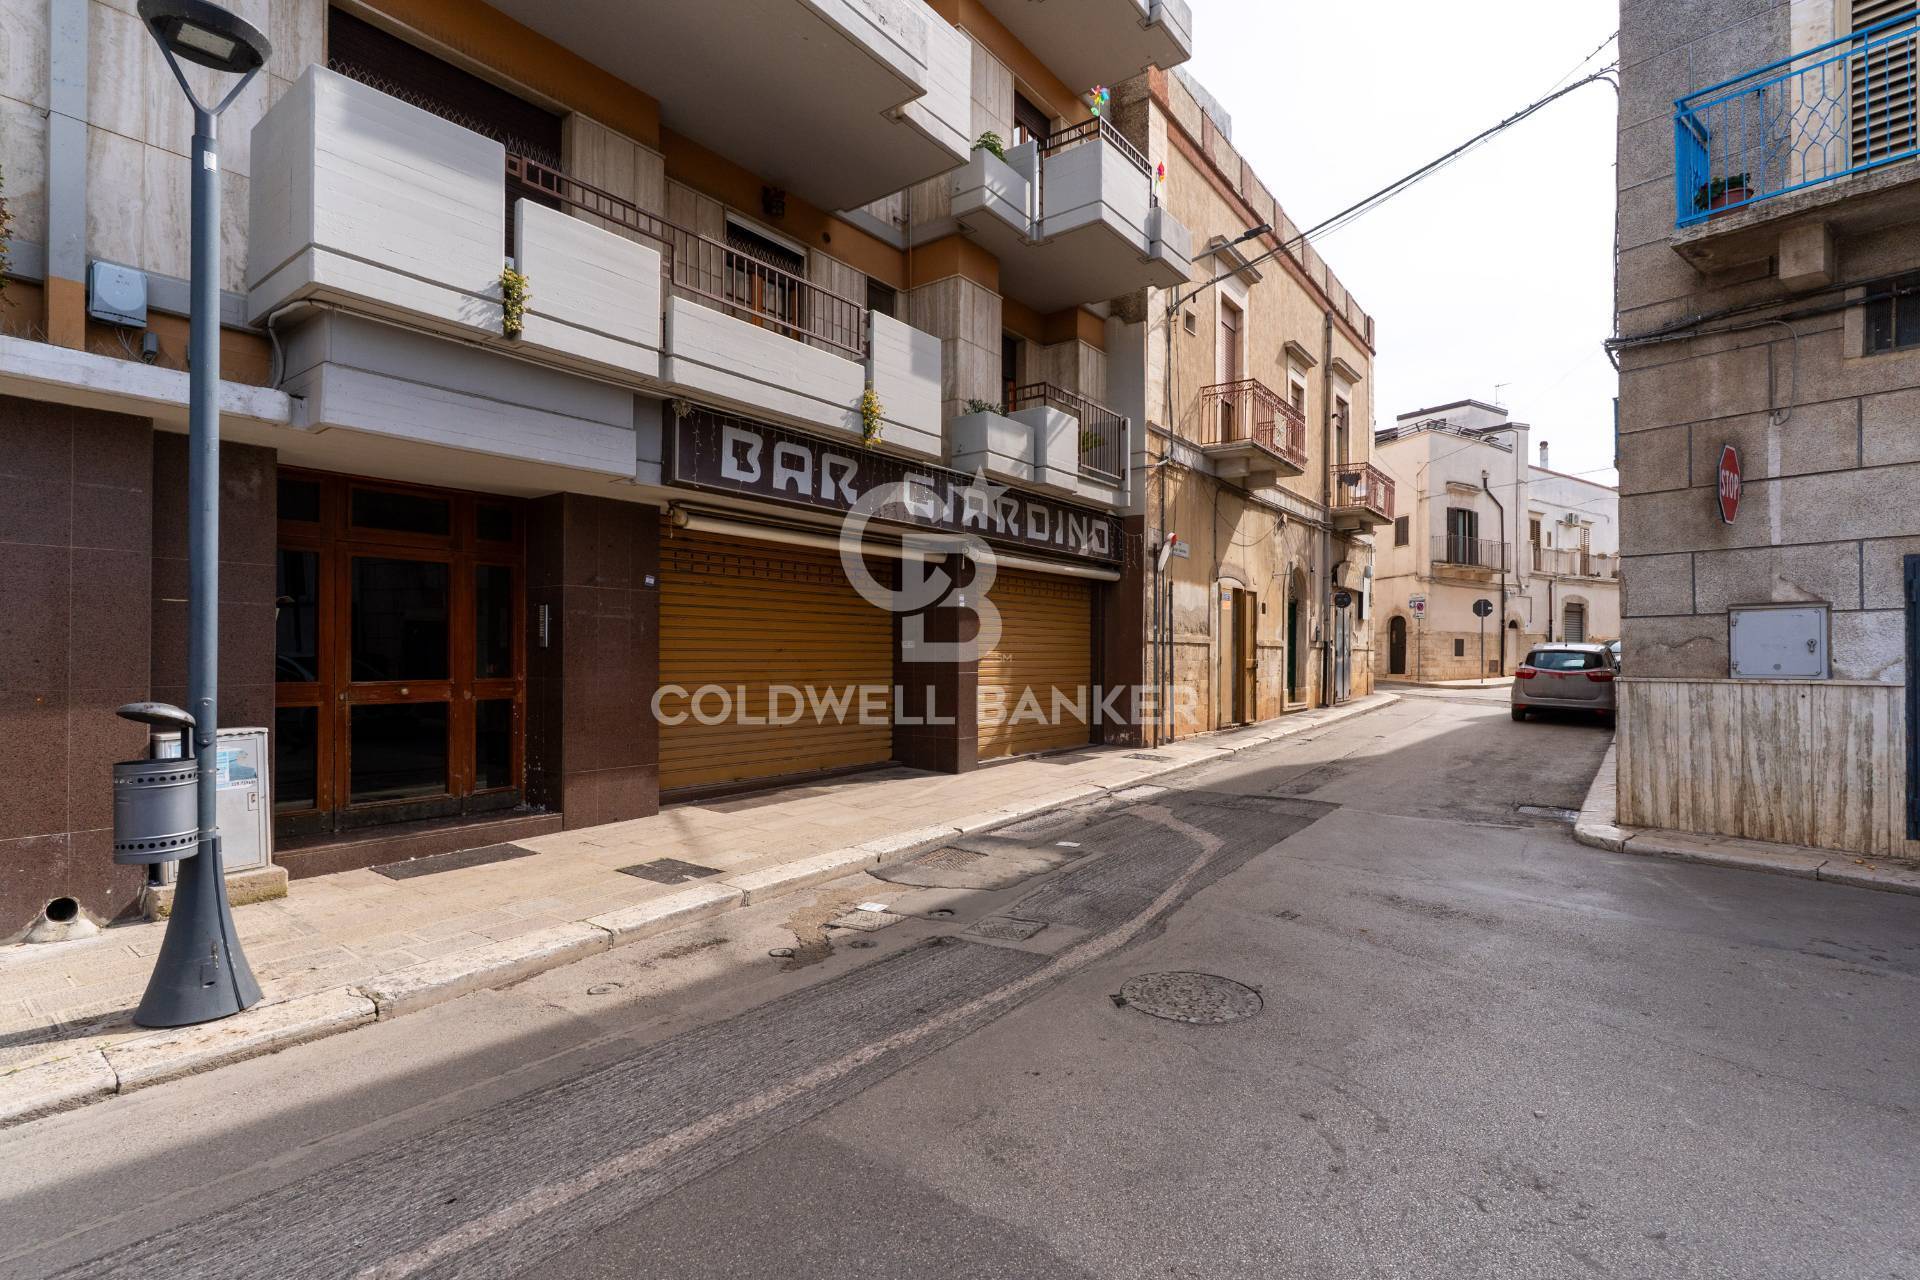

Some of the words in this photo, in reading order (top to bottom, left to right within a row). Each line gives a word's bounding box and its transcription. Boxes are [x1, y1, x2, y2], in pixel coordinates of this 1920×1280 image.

[722, 426, 858, 504] BAR
[904, 473, 1109, 555] GIARDINO
[1721, 469, 1739, 500] STOP
